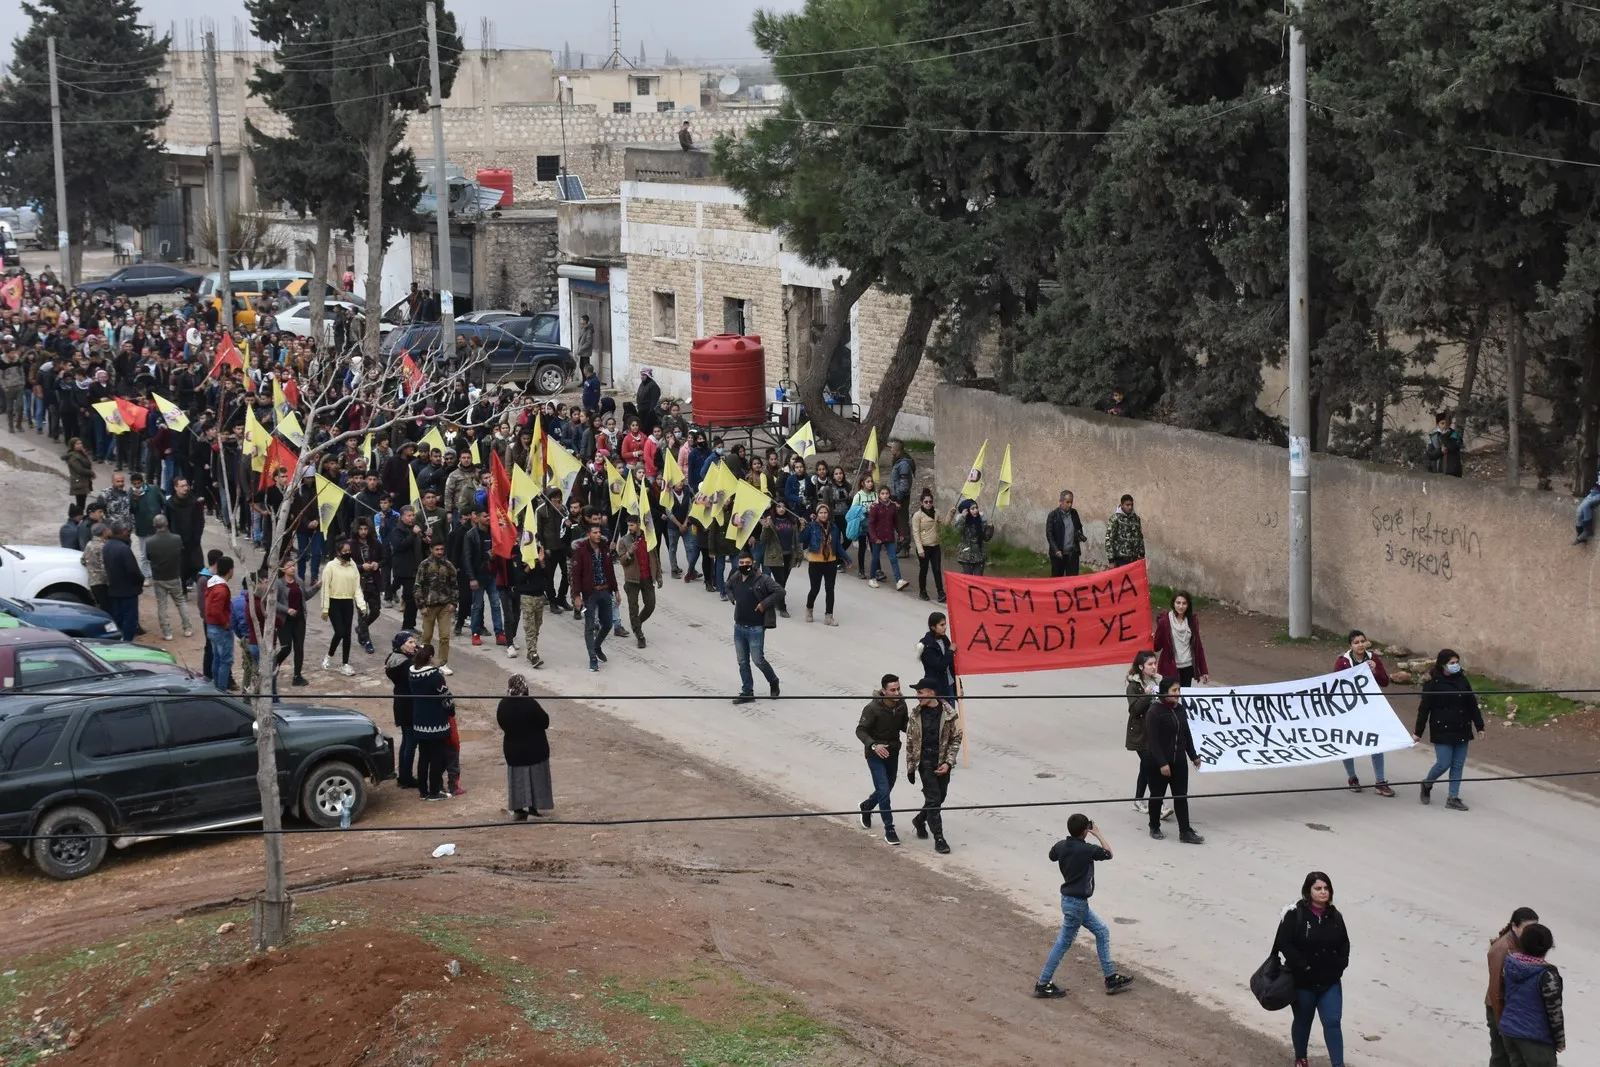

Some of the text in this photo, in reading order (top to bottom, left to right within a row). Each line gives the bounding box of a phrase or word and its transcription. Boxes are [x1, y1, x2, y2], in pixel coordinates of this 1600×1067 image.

[968, 573, 1138, 614] DEM DEMA
[967, 609, 1138, 651] AZADÎ YE
[1236, 743, 1348, 766] GERÎLA
